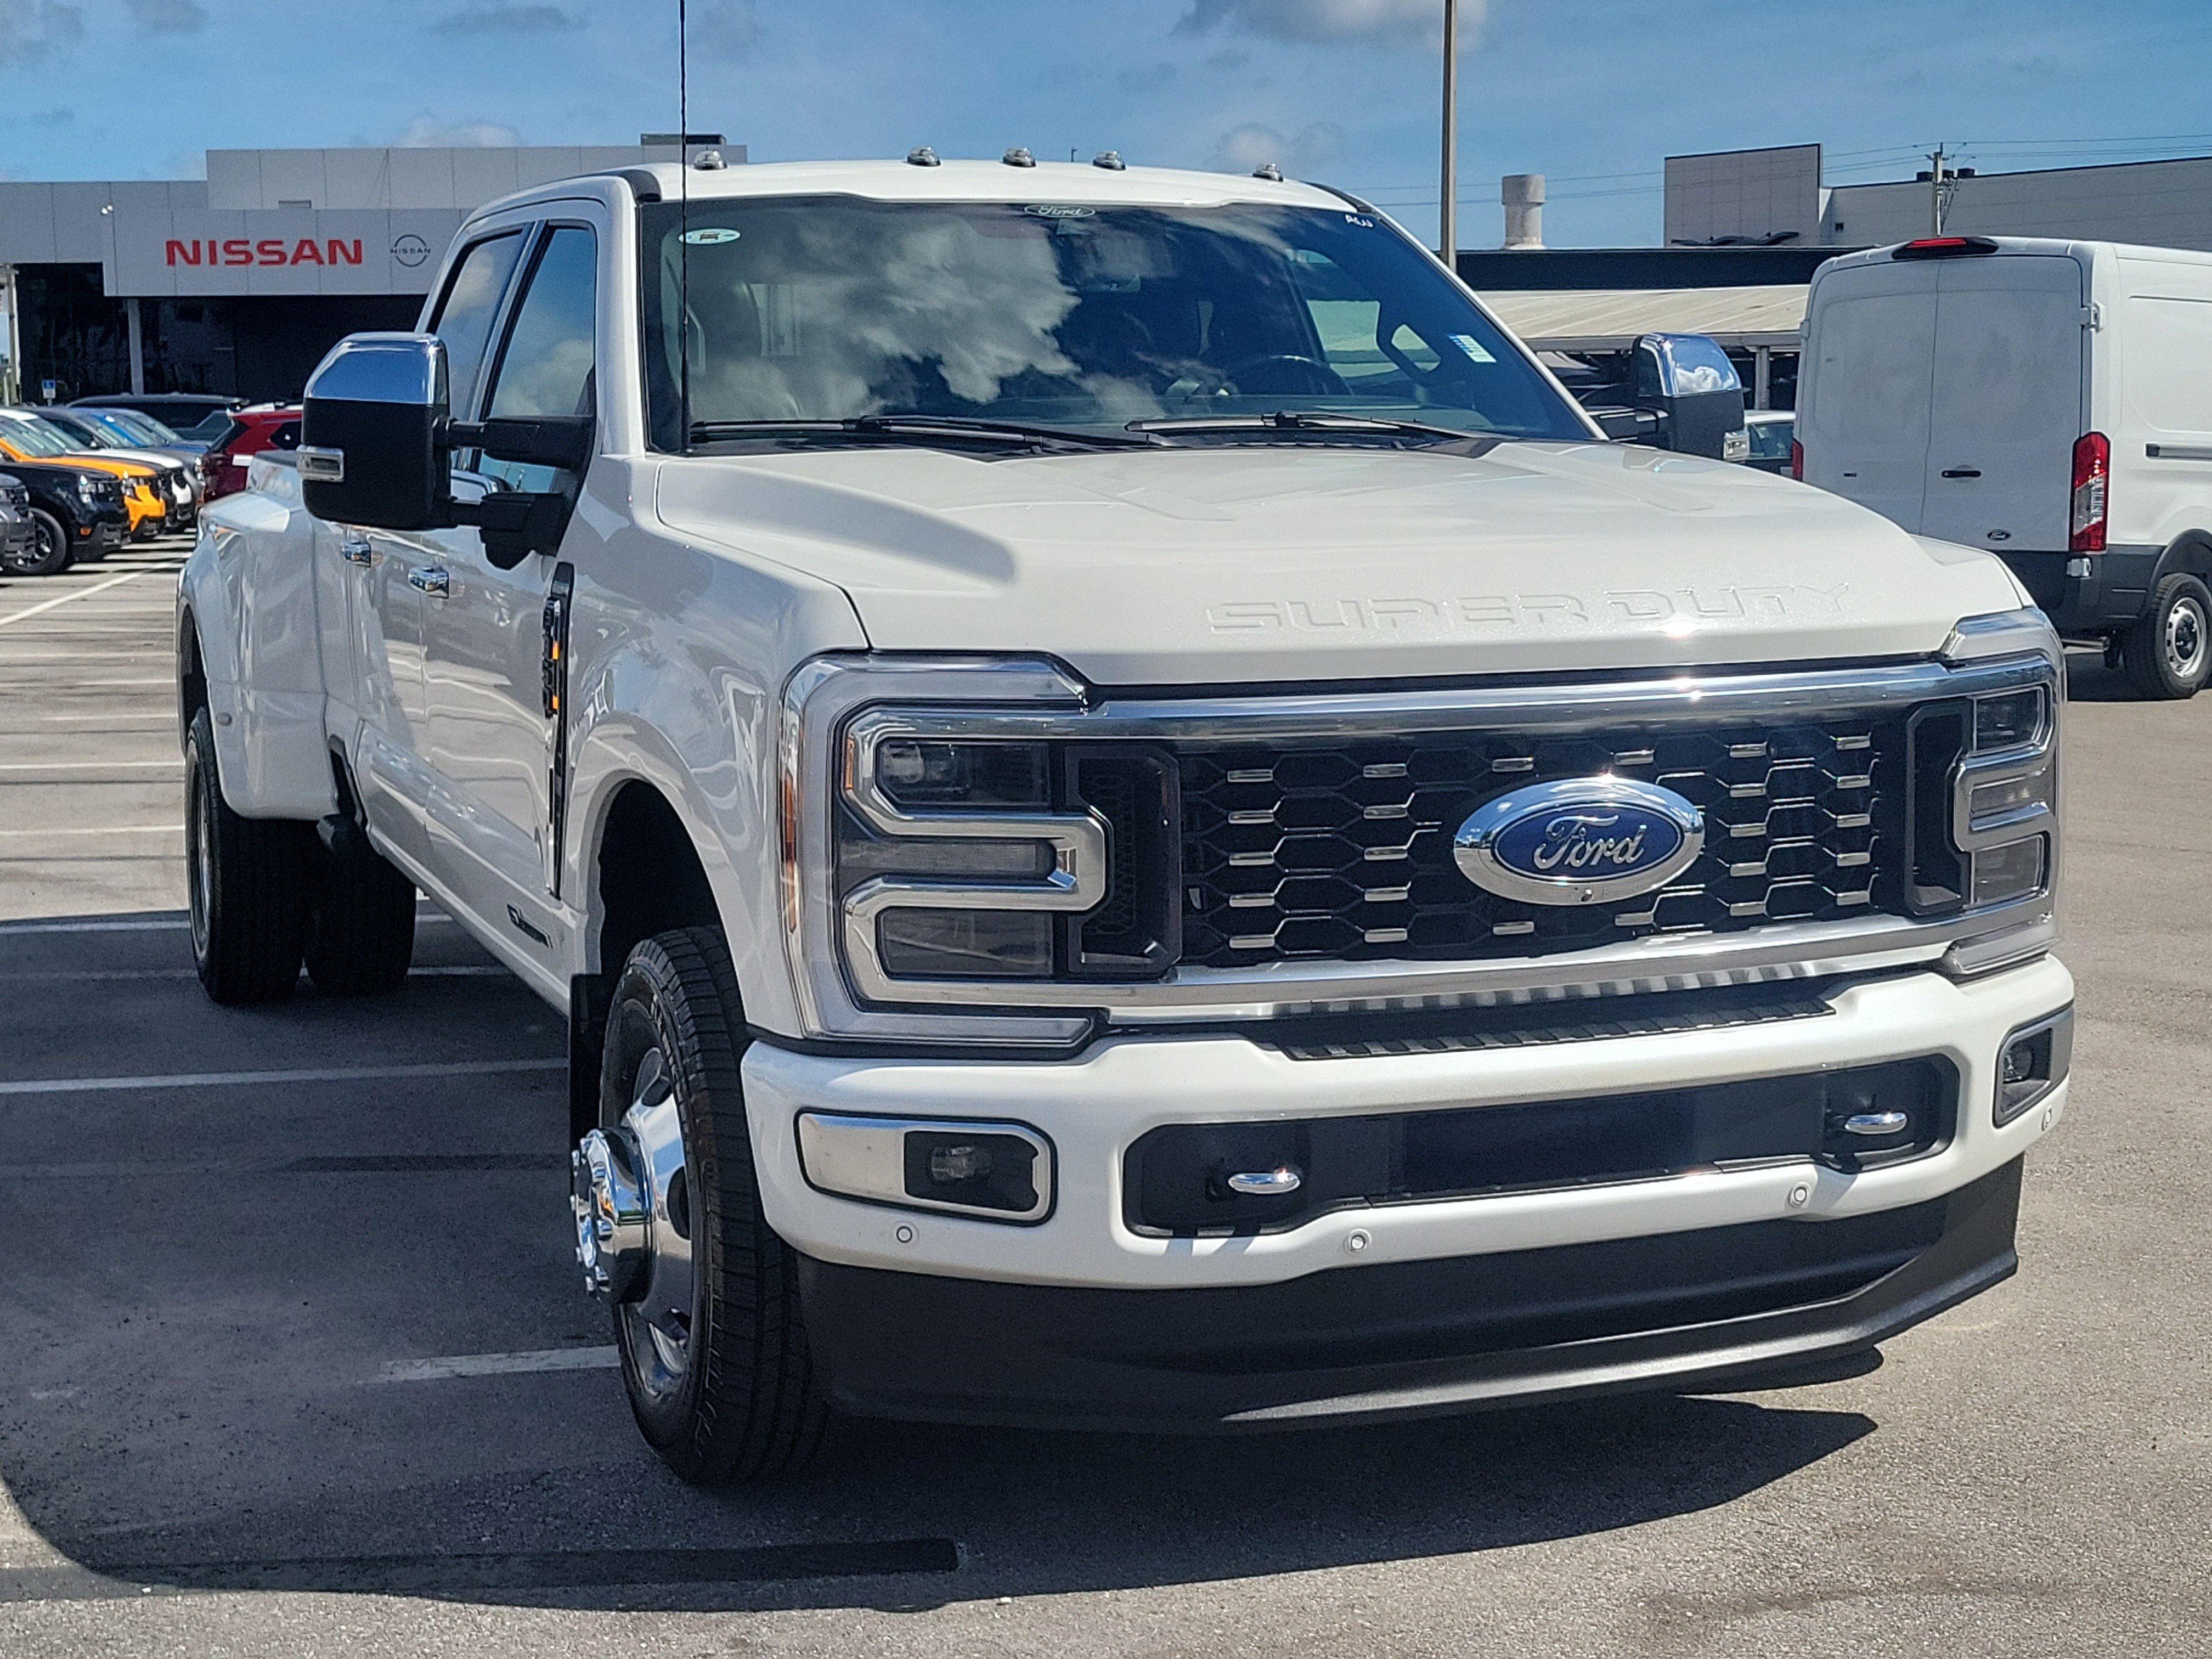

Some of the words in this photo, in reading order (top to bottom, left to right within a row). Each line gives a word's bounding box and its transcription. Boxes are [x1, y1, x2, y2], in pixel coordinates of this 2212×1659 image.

[1038, 206, 1084, 216] Ford
[165, 239, 363, 266] NISSAN
[1206, 594, 1589, 634] SUPER
[1602, 583, 1849, 622] DUTY
[1533, 815, 1646, 870] Ford
